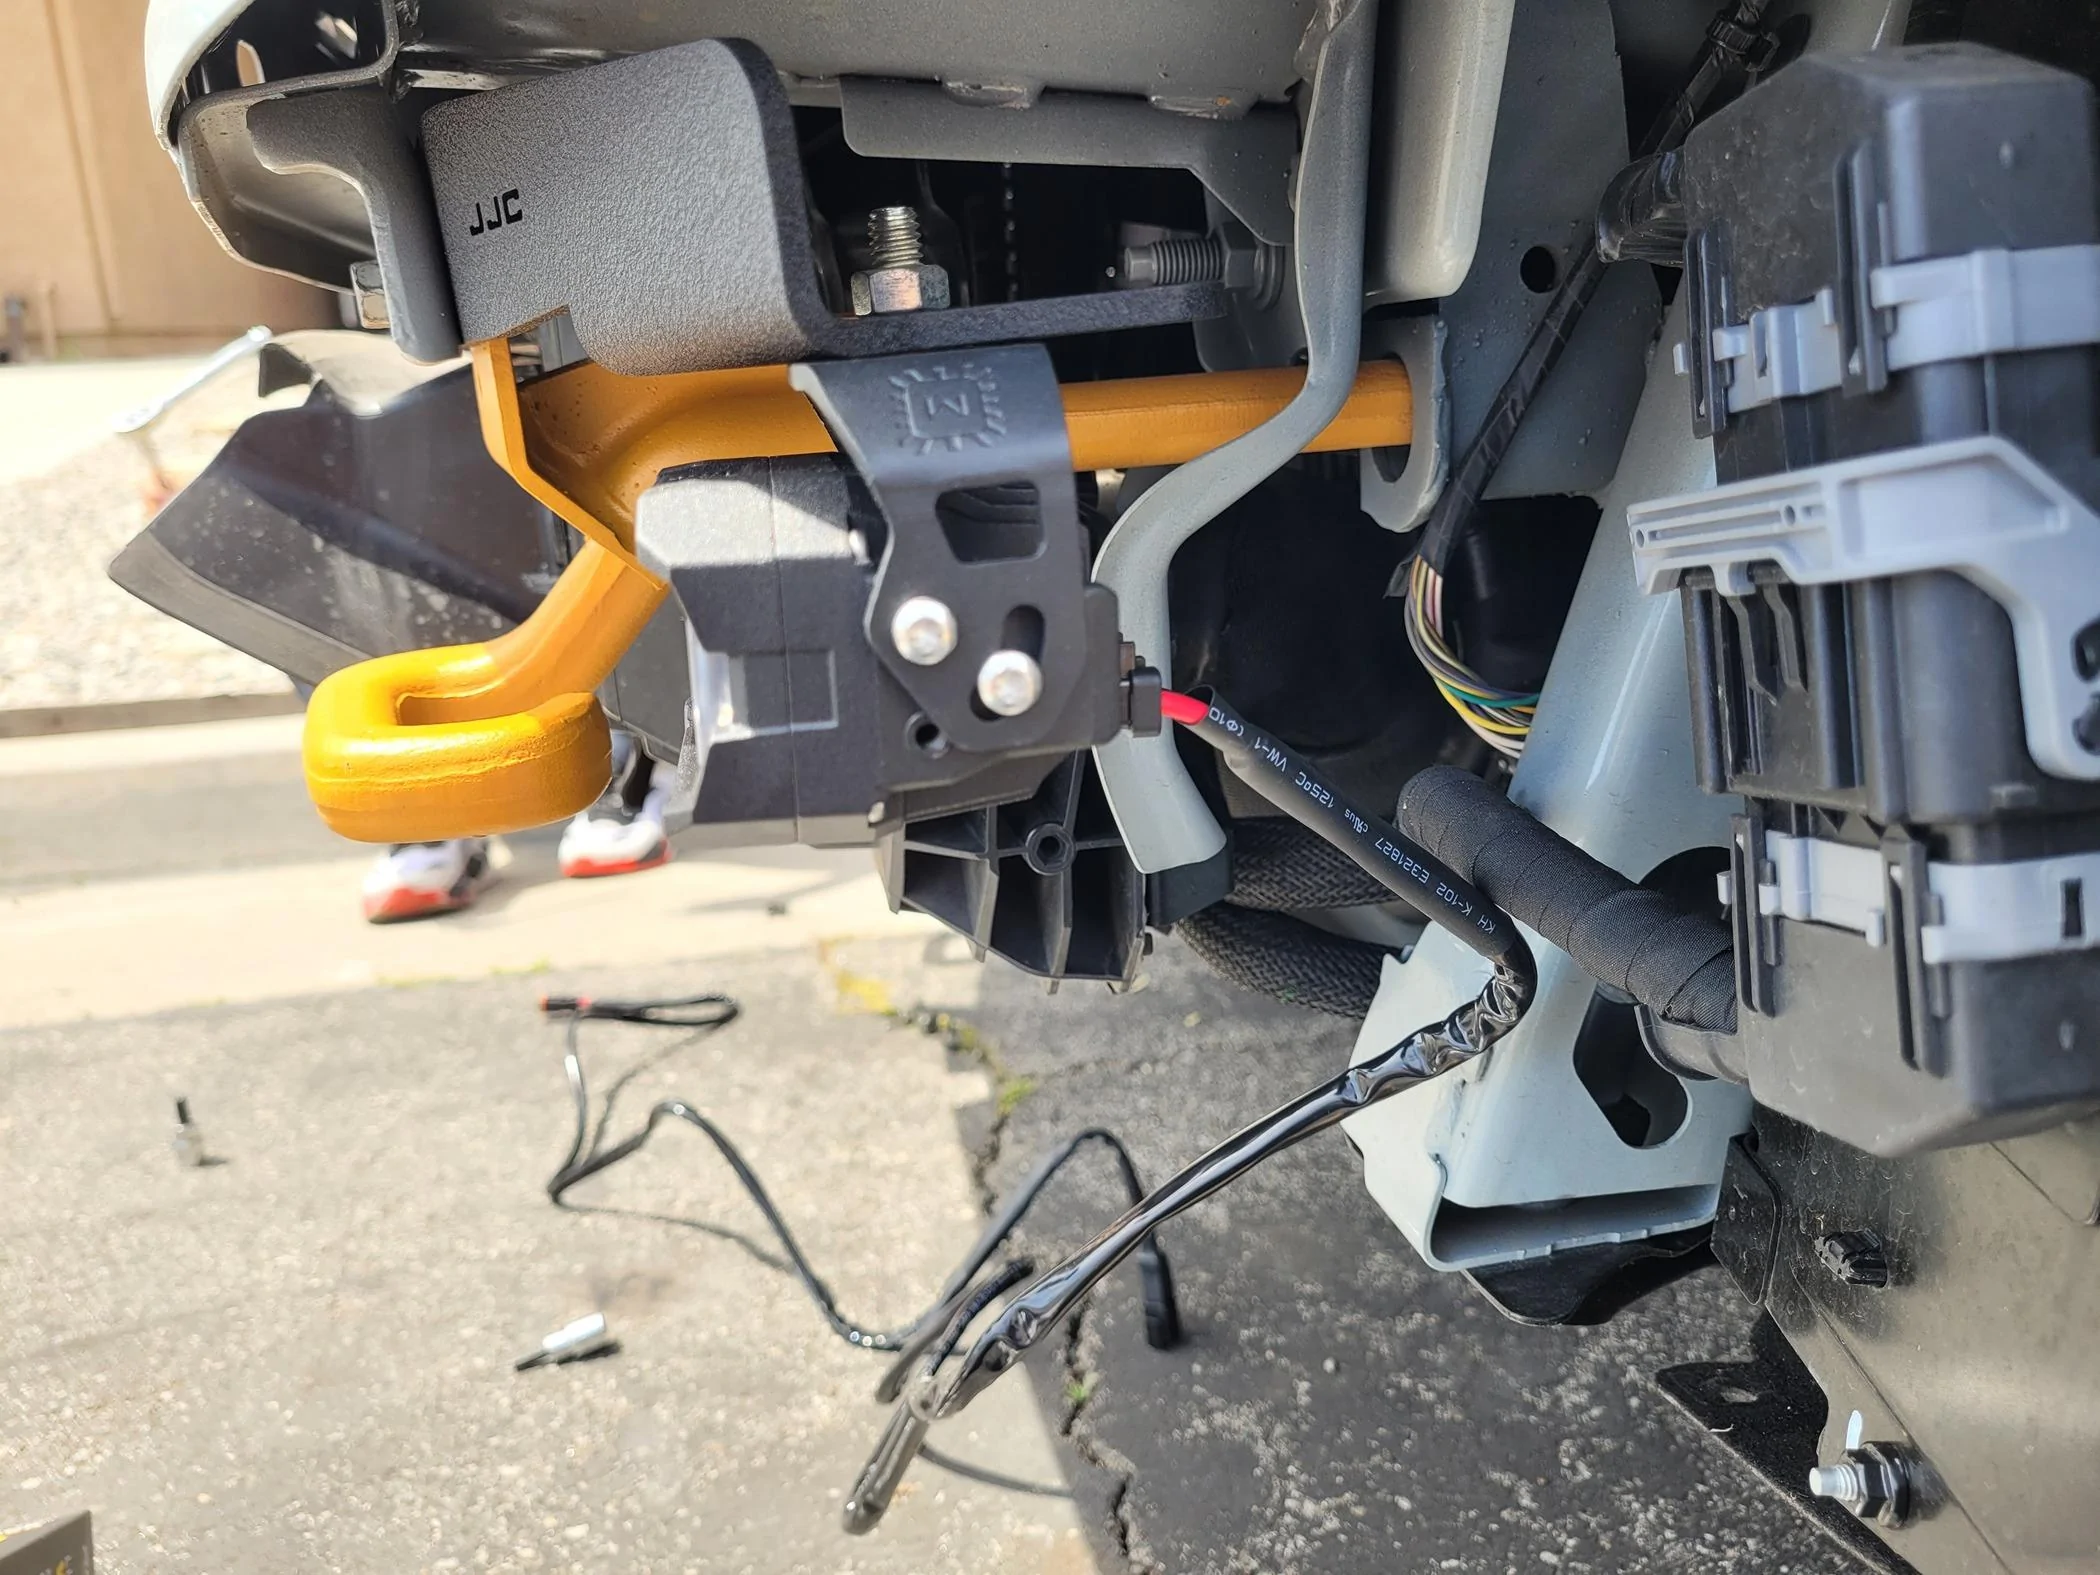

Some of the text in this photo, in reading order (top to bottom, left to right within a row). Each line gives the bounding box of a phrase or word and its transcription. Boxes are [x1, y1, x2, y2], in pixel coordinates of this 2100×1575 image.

[469, 188, 522, 237] JJC
[1253, 736, 1288, 773] VW-1
[1374, 837, 1431, 884] E321827
[1435, 881, 1473, 917] K-102
[1476, 914, 1497, 935] KH
